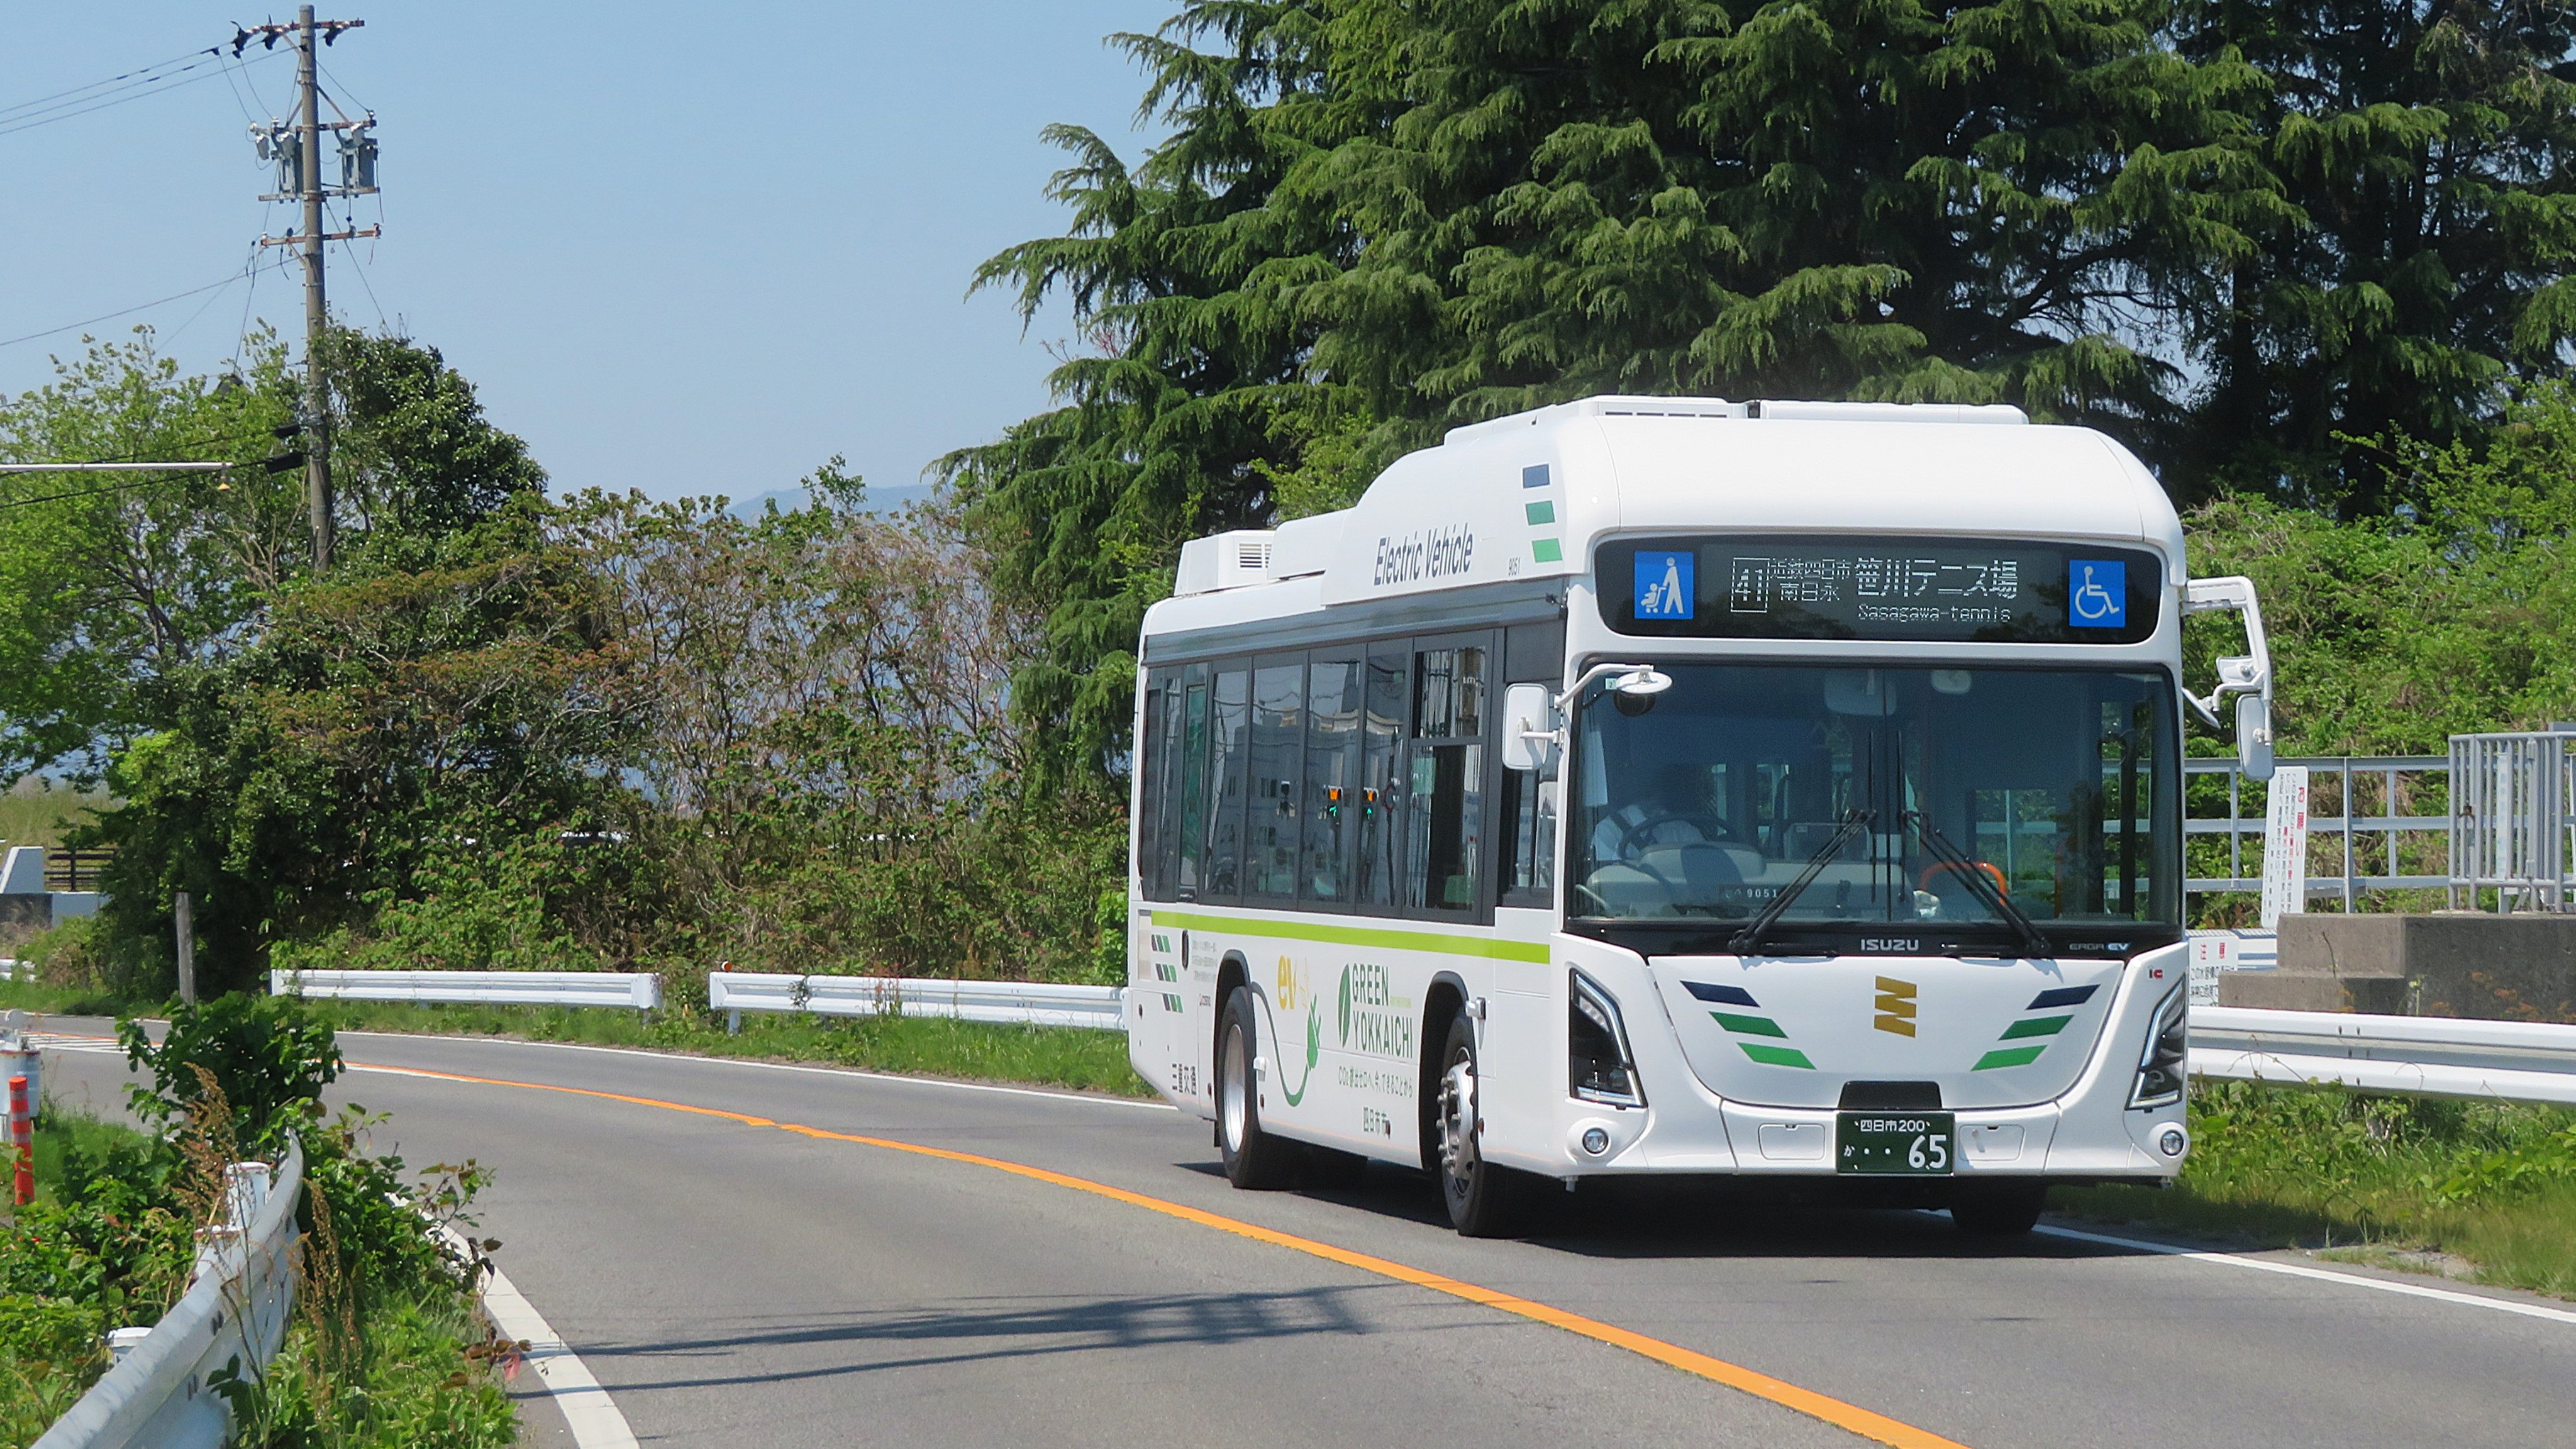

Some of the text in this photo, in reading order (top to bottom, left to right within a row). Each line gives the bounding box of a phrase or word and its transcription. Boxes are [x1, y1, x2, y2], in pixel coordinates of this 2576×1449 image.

[1374, 522, 1473, 586] Electric Vehicle
[1508, 557, 1521, 576] 9051
[1734, 568, 1762, 602] 41
[1780, 582, 1840, 602] 南日永
[1855, 557, 2018, 599] 笹川テニス場
[1746, 889, 1778, 898] 9051
[1861, 939, 1919, 952] ISUZU
[2108, 943, 2130, 951] EV
[1352, 963, 1389, 1006] GREEN
[1353, 1010, 1413, 1058] YOKKAICHI
[1172, 1063, 1196, 1095] 三重交通
[1844, 1135, 1946, 1169] か 65
